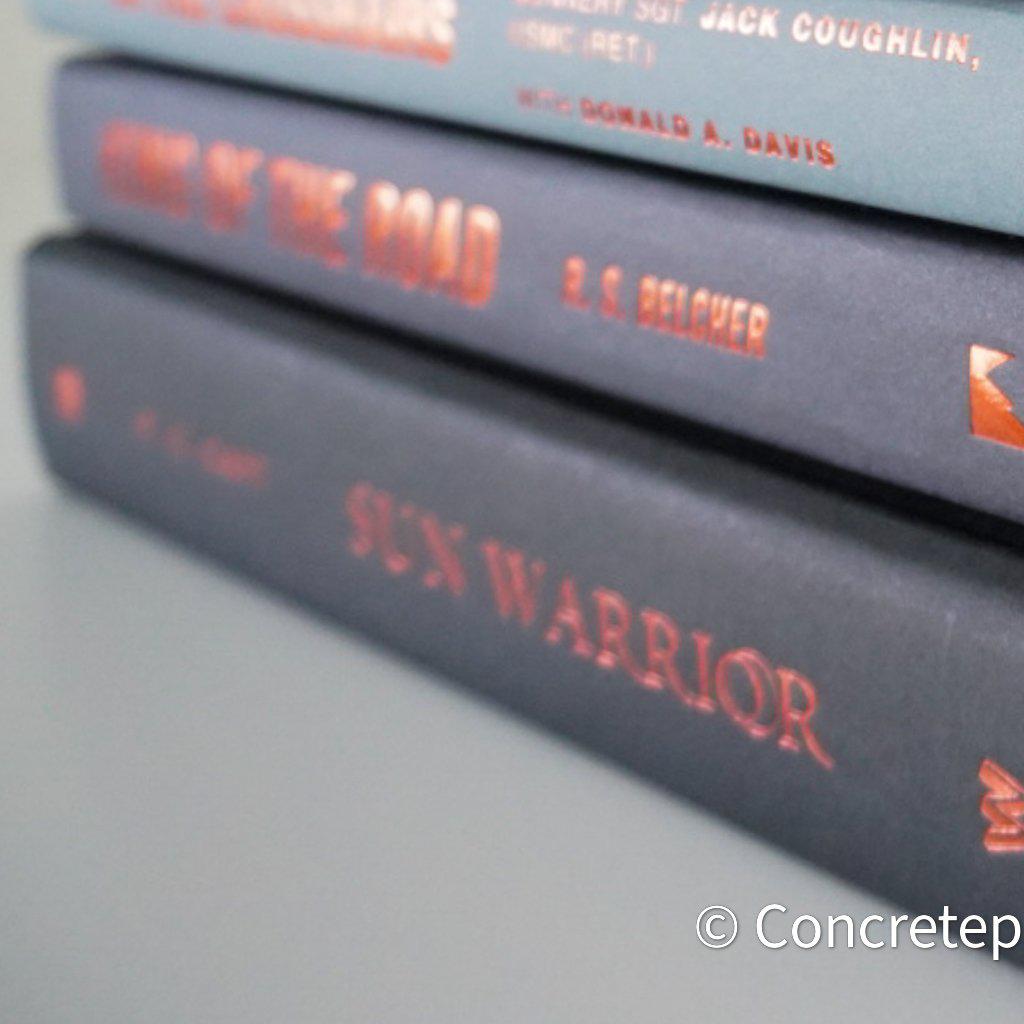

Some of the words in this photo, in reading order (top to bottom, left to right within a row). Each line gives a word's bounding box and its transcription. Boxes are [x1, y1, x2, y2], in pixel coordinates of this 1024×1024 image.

[699, 2, 780, 38] JACK
[792, 10, 981, 72] COUGHLIN,
[579, 95, 691, 141] DONALD
[703, 119, 733, 149] A.
[742, 125, 837, 169] DAVIS
[362, 180, 500, 308] ROAD
[637, 274, 770, 359] BELCHER
[344, 482, 468, 596] SUN
[481, 538, 834, 770] WARRIOR
